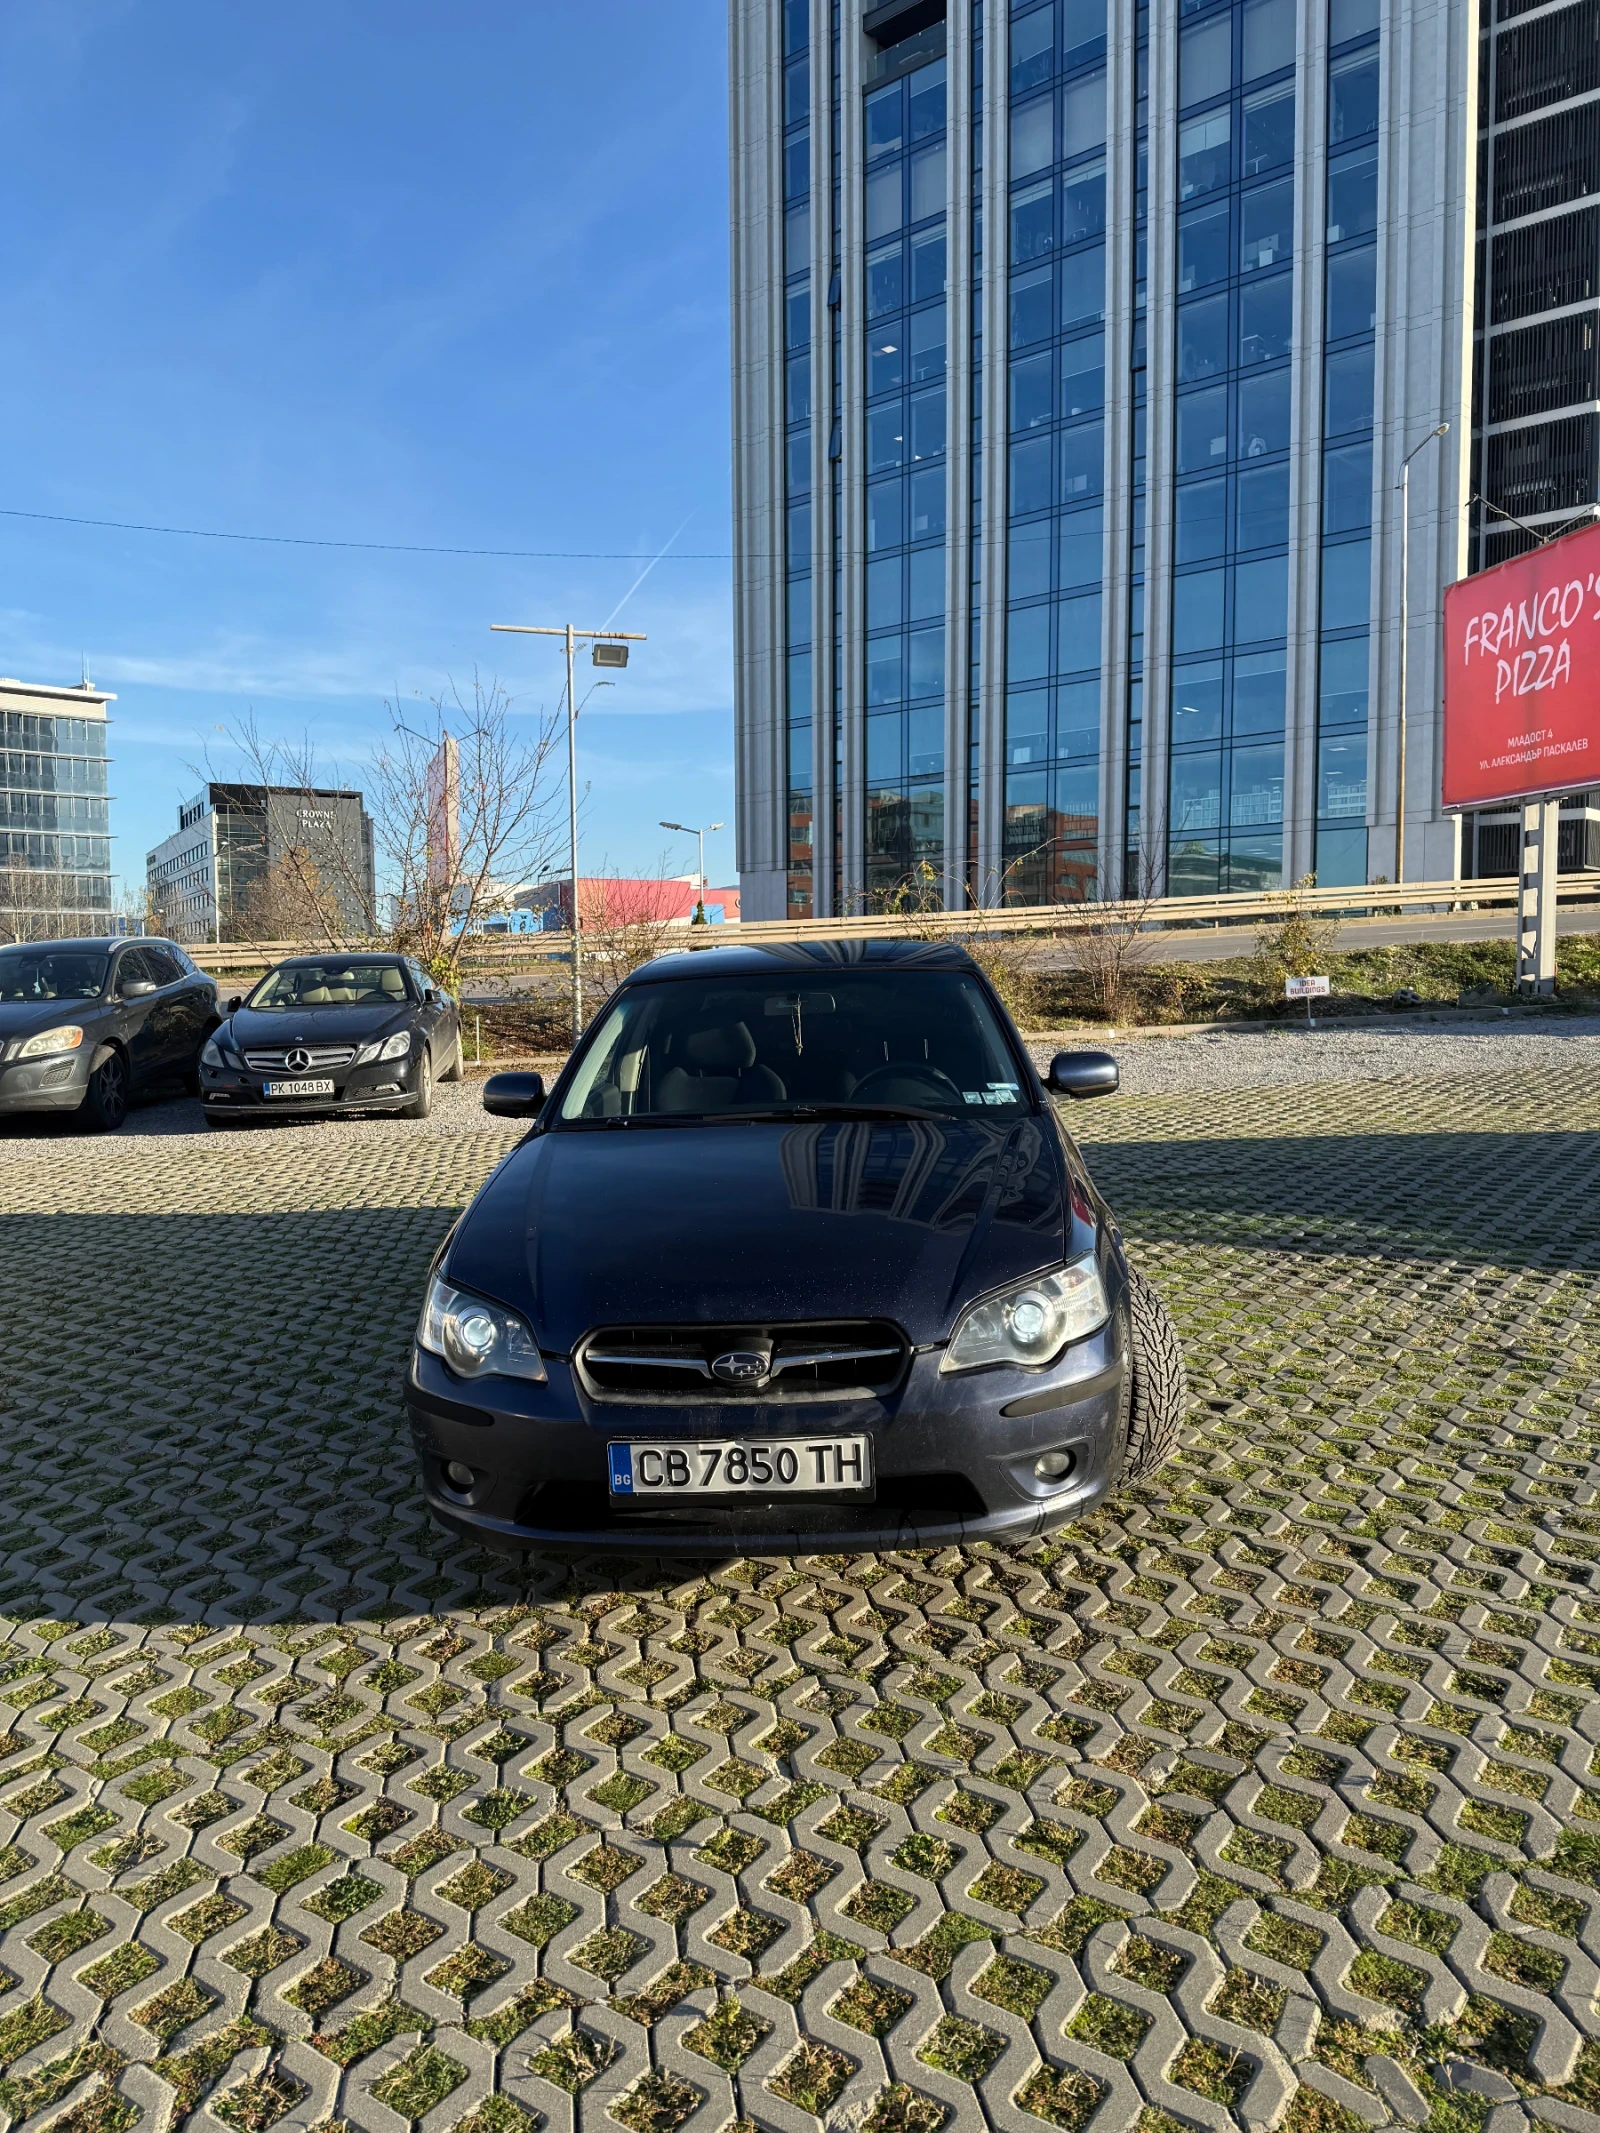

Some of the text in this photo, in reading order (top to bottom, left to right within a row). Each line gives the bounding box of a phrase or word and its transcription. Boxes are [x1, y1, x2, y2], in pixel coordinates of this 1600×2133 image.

[1495, 638, 1571, 704] PIZZA
[1507, 728, 1554, 748] МЛАДОСТ 4
[1479, 738, 1589, 770] УЛ. АЛЕКСАНДЪР ПАСКАЛЕВ
[302, 819, 332, 829] PLAZA
[1290, 986, 1326, 995] BUILDINGS
[271, 1083, 285, 1095] PK
[289, 1082, 315, 1093] 1048
[316, 1080, 331, 1092] BX
[639, 1443, 862, 1487] CB 7850 TH
[614, 1474, 631, 1486] BG
